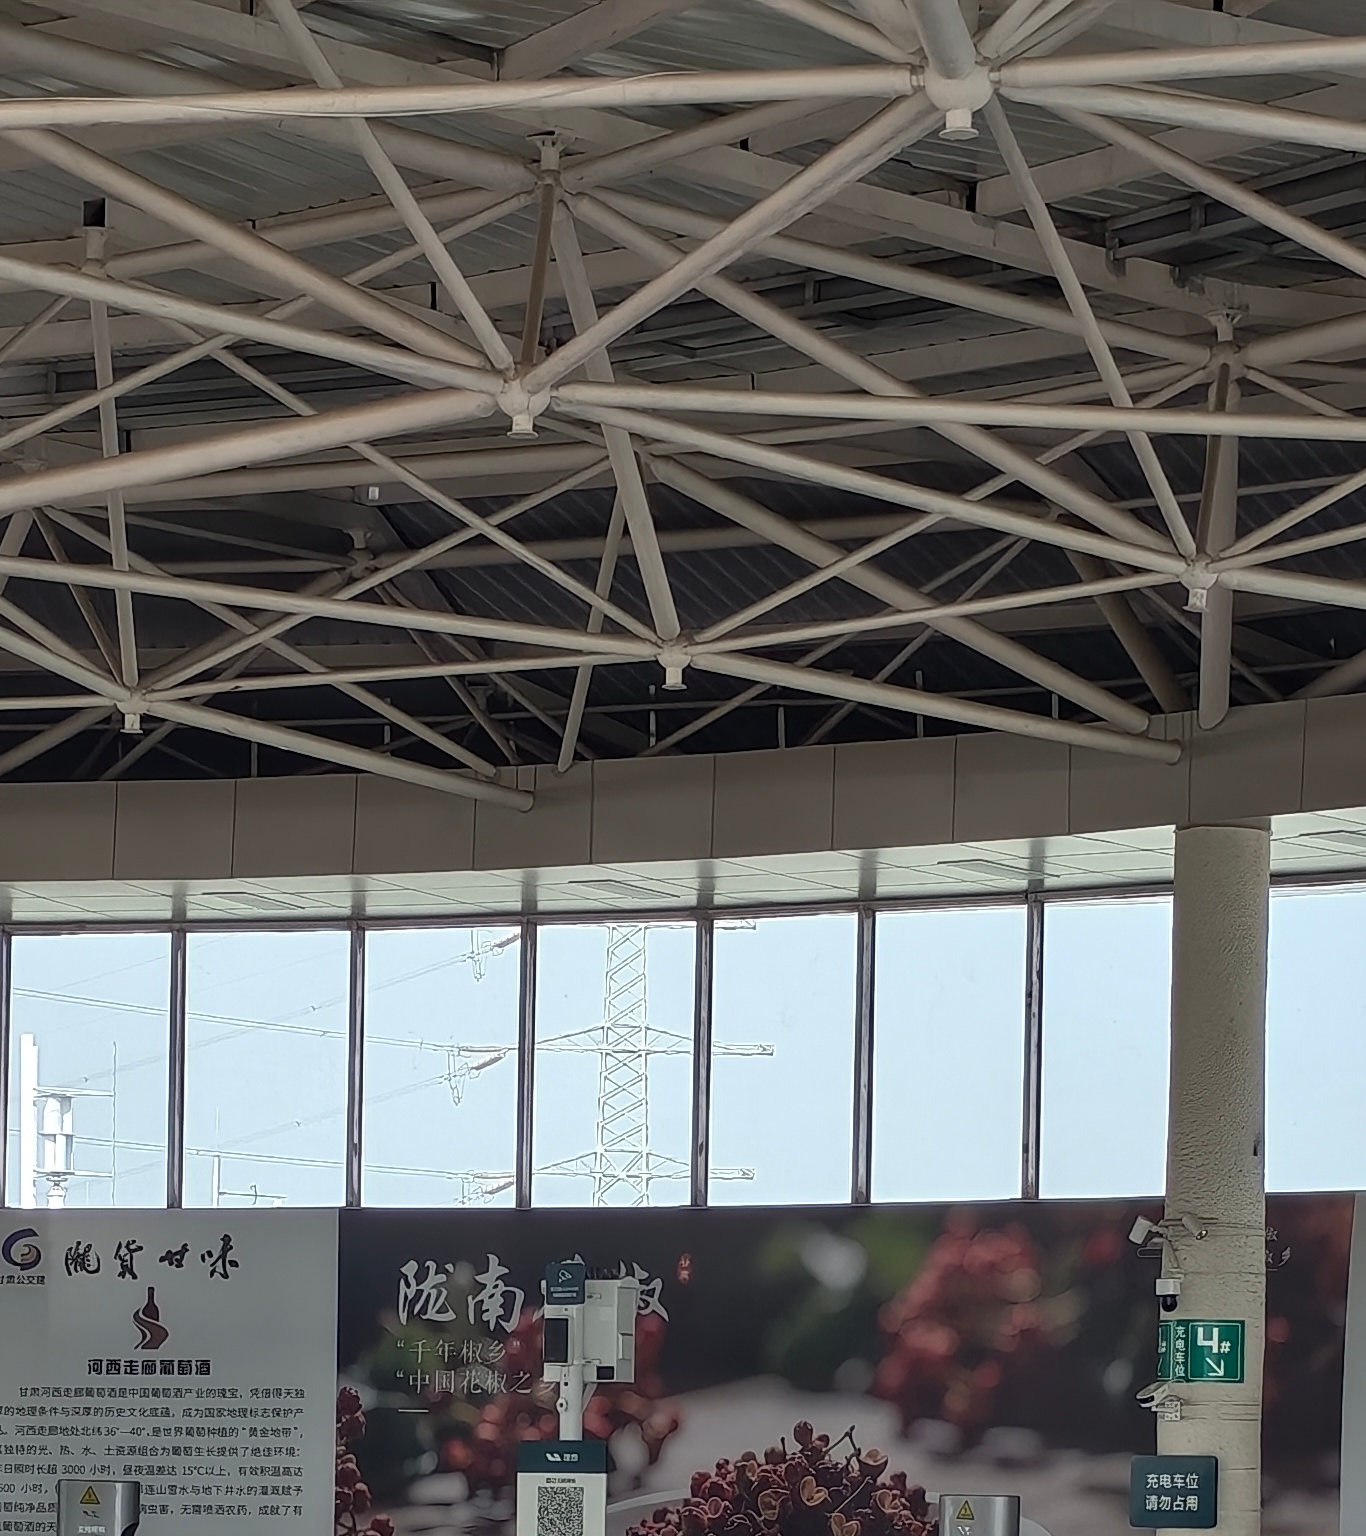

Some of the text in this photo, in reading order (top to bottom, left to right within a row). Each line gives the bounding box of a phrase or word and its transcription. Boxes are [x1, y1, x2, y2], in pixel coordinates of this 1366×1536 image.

[1196, 1326, 1231, 1354] 4#
[1175, 1325, 1186, 1377] 充电车位
[87, 1359, 212, 1376] 河西走廊葡萄酒
[61, 1464, 86, 1475] 3000
[1146, 1473, 1199, 1489] 充电车位
[1145, 1495, 1199, 1512] 请勿占用
